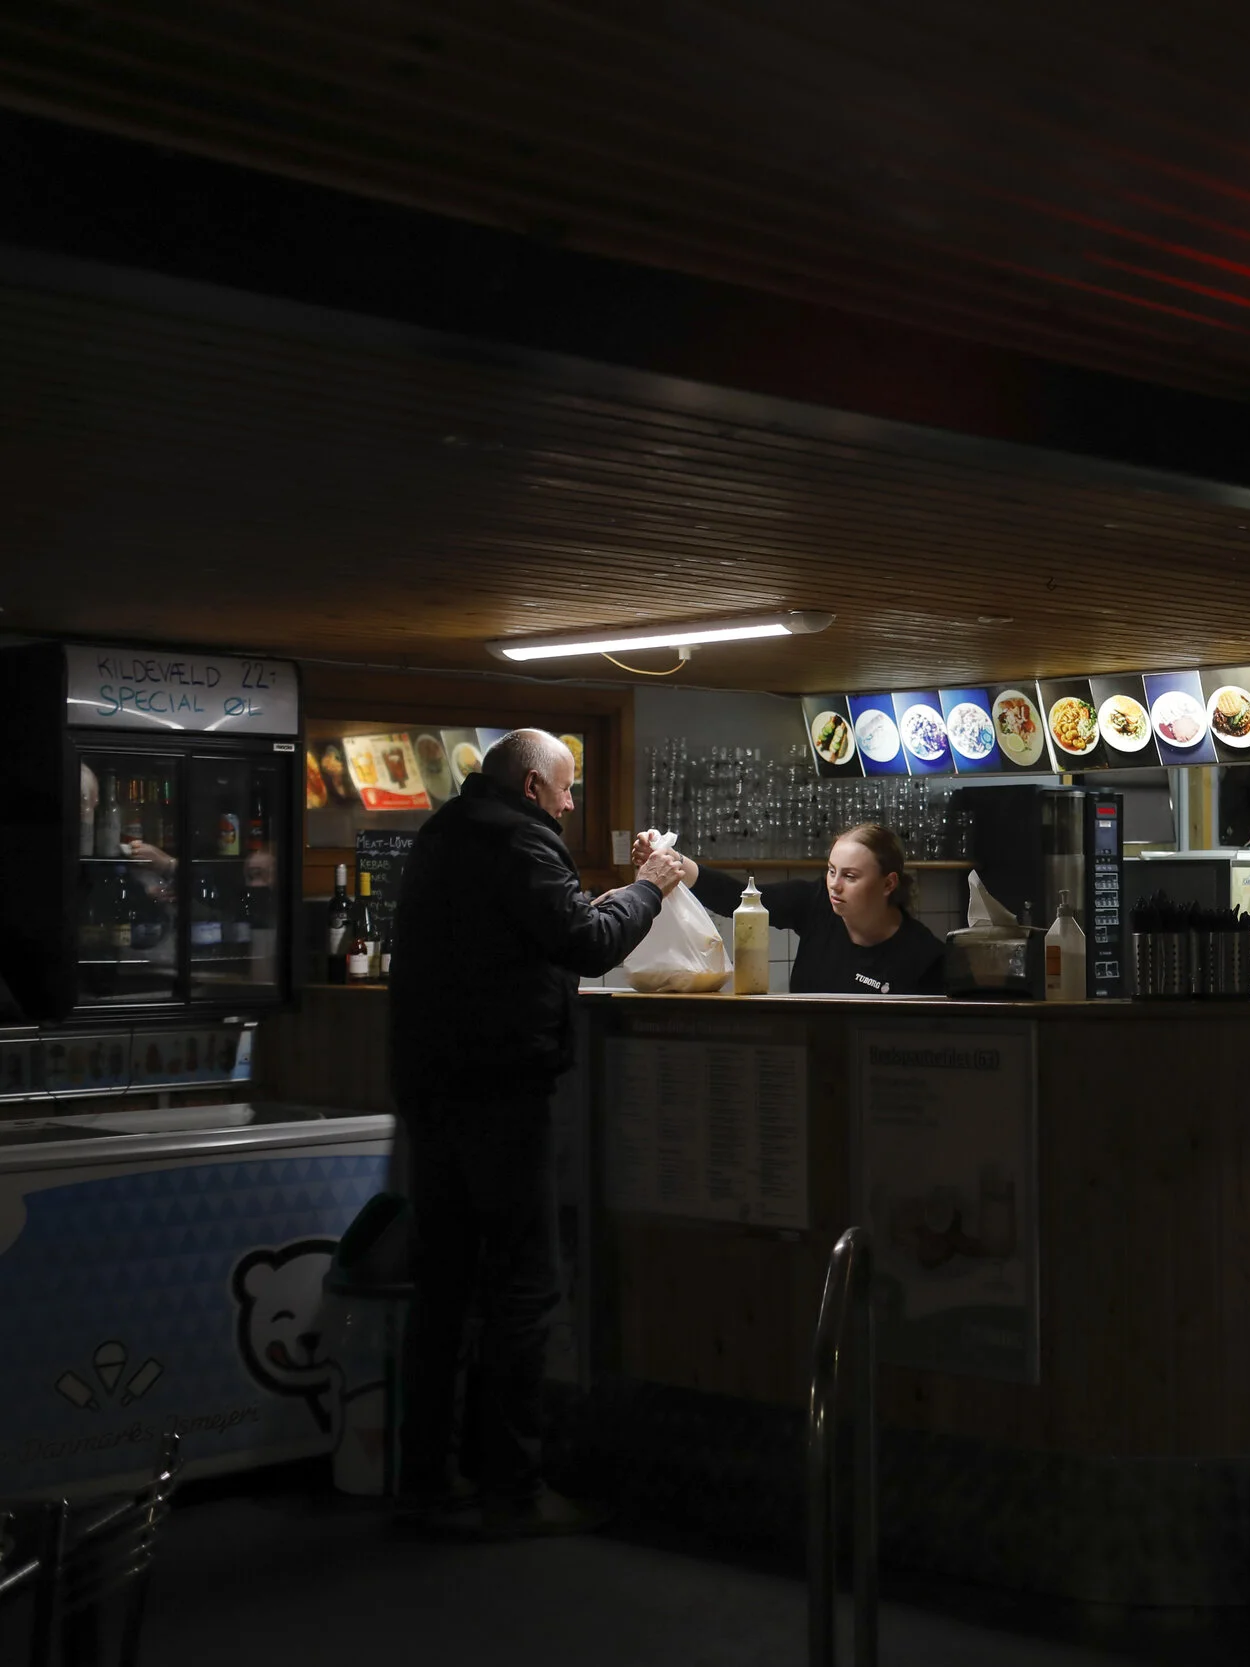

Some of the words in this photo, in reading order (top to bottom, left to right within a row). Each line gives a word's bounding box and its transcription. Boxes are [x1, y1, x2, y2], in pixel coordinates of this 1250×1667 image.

[97, 657, 221, 688] KILDEVÆLD
[97, 685, 205, 716] SPECIAL
[223, 696, 264, 716] ØL
[360, 858, 390, 870] KEBAB
[855, 973, 881, 989] TUBORG
